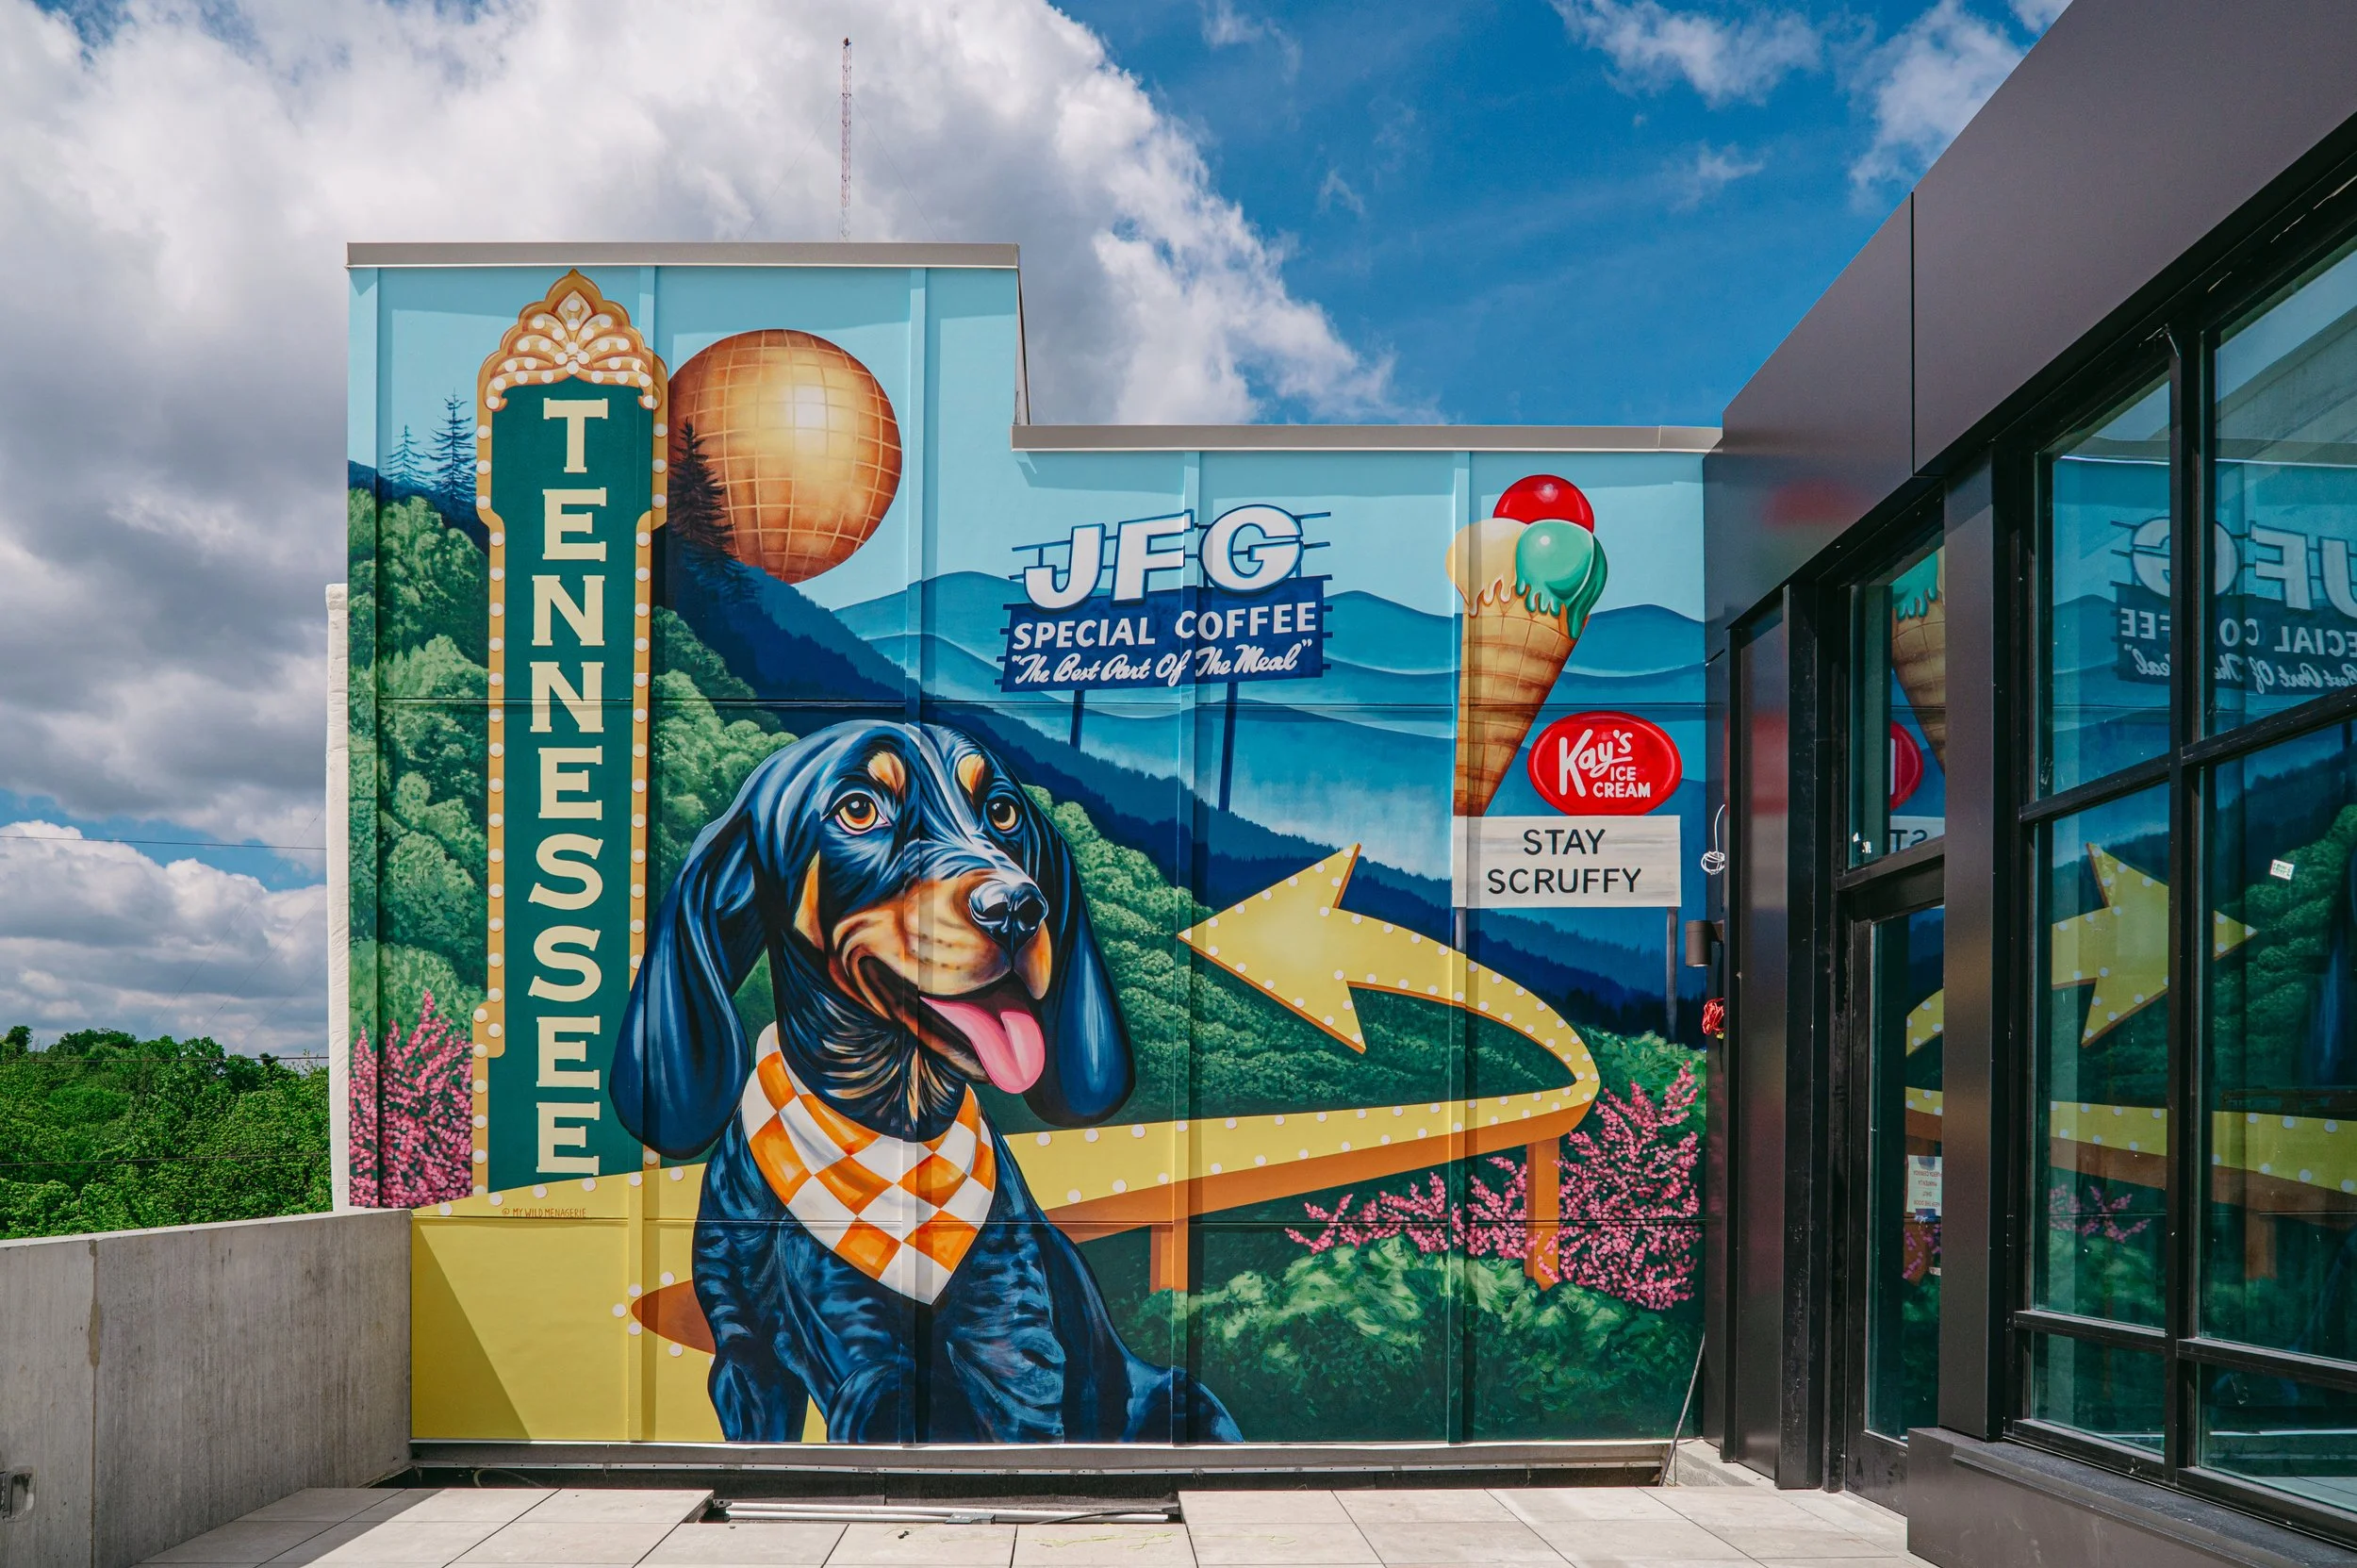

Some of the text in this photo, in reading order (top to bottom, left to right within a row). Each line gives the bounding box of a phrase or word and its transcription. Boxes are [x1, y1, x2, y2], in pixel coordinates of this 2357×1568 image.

[1024, 503, 1304, 611] JFG
[1012, 602, 1317, 650] SPECIAL COFFEE
[1052, 652, 1102, 683] Best
[1100, 653, 1152, 682] Part
[1155, 649, 1193, 687] Of
[1195, 646, 1231, 678] The
[1558, 728, 1634, 798] Kay's
[1610, 766, 1637, 782] ICE
[529, 398, 608, 1176] TENNESSEE
[1592, 782, 1651, 799] CREAM
[1523, 828, 1606, 855] STAY
[1487, 867, 1642, 895] SCRUFFY
[512, 1208, 523, 1217] MY
[524, 1208, 544, 1218] WILD
[544, 1208, 586, 1219] MENAGERIE
